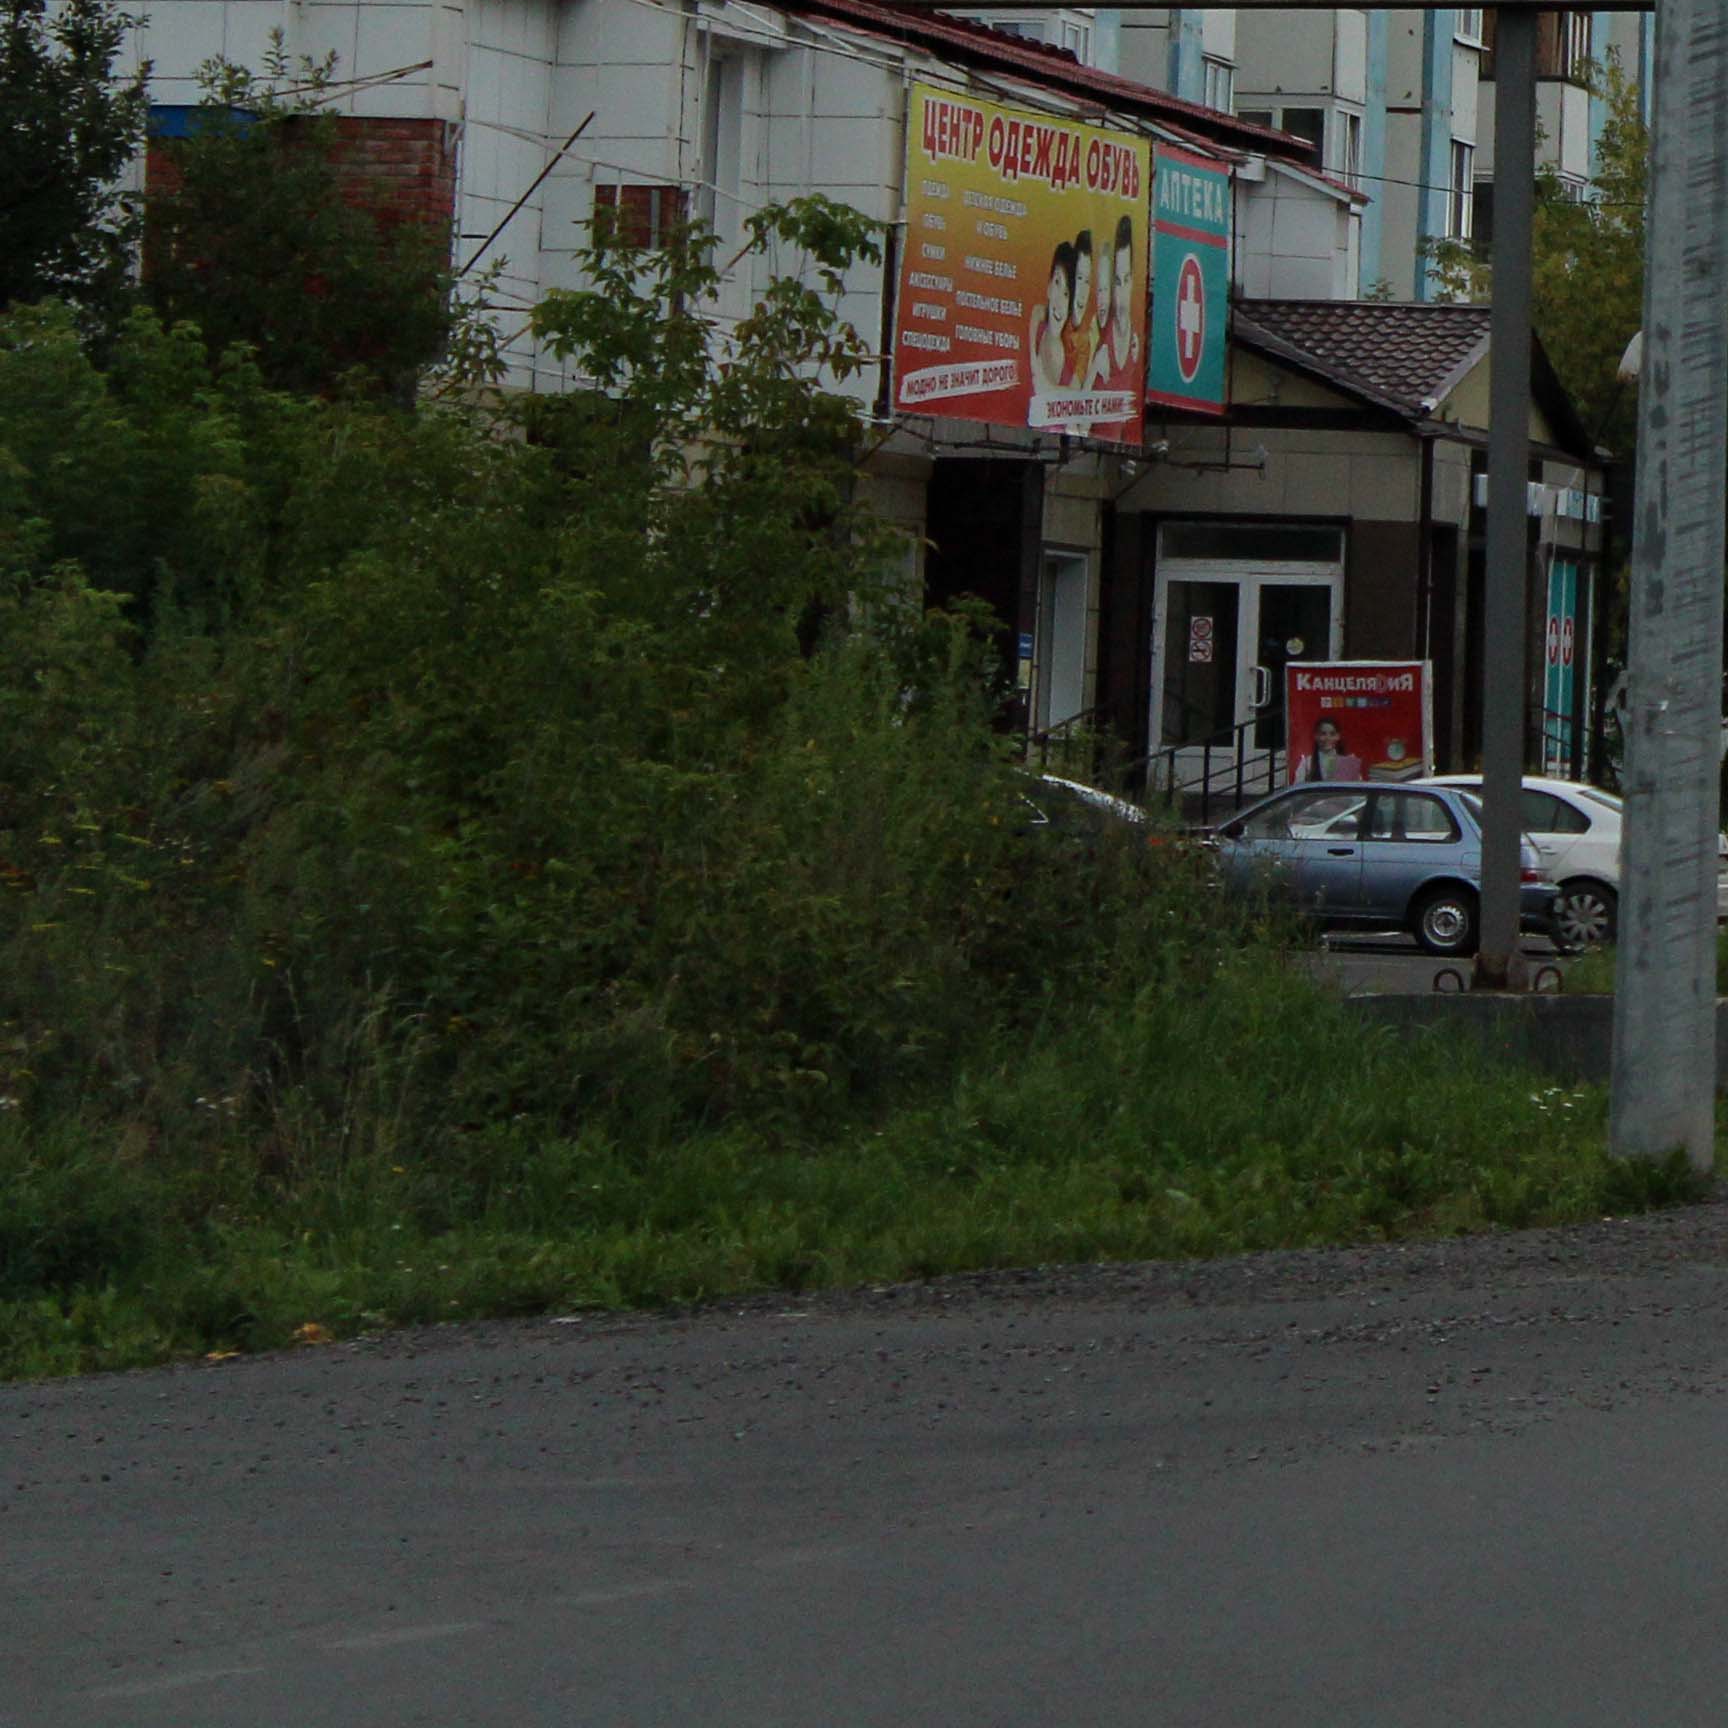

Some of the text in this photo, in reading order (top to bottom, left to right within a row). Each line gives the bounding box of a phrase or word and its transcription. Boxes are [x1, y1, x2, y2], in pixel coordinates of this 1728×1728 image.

[922, 99, 1141, 200] ЦЕНТР ОДЕЖДА ОБУВЬ
[1160, 171, 1225, 225] АПТЕКА
[906, 376, 937, 399] МОДНО
[938, 374, 949, 390] НЕ
[950, 370, 980, 389] ЗНАЧИТ
[1046, 398, 1093, 418] ЭКОНОМЬТЕ
